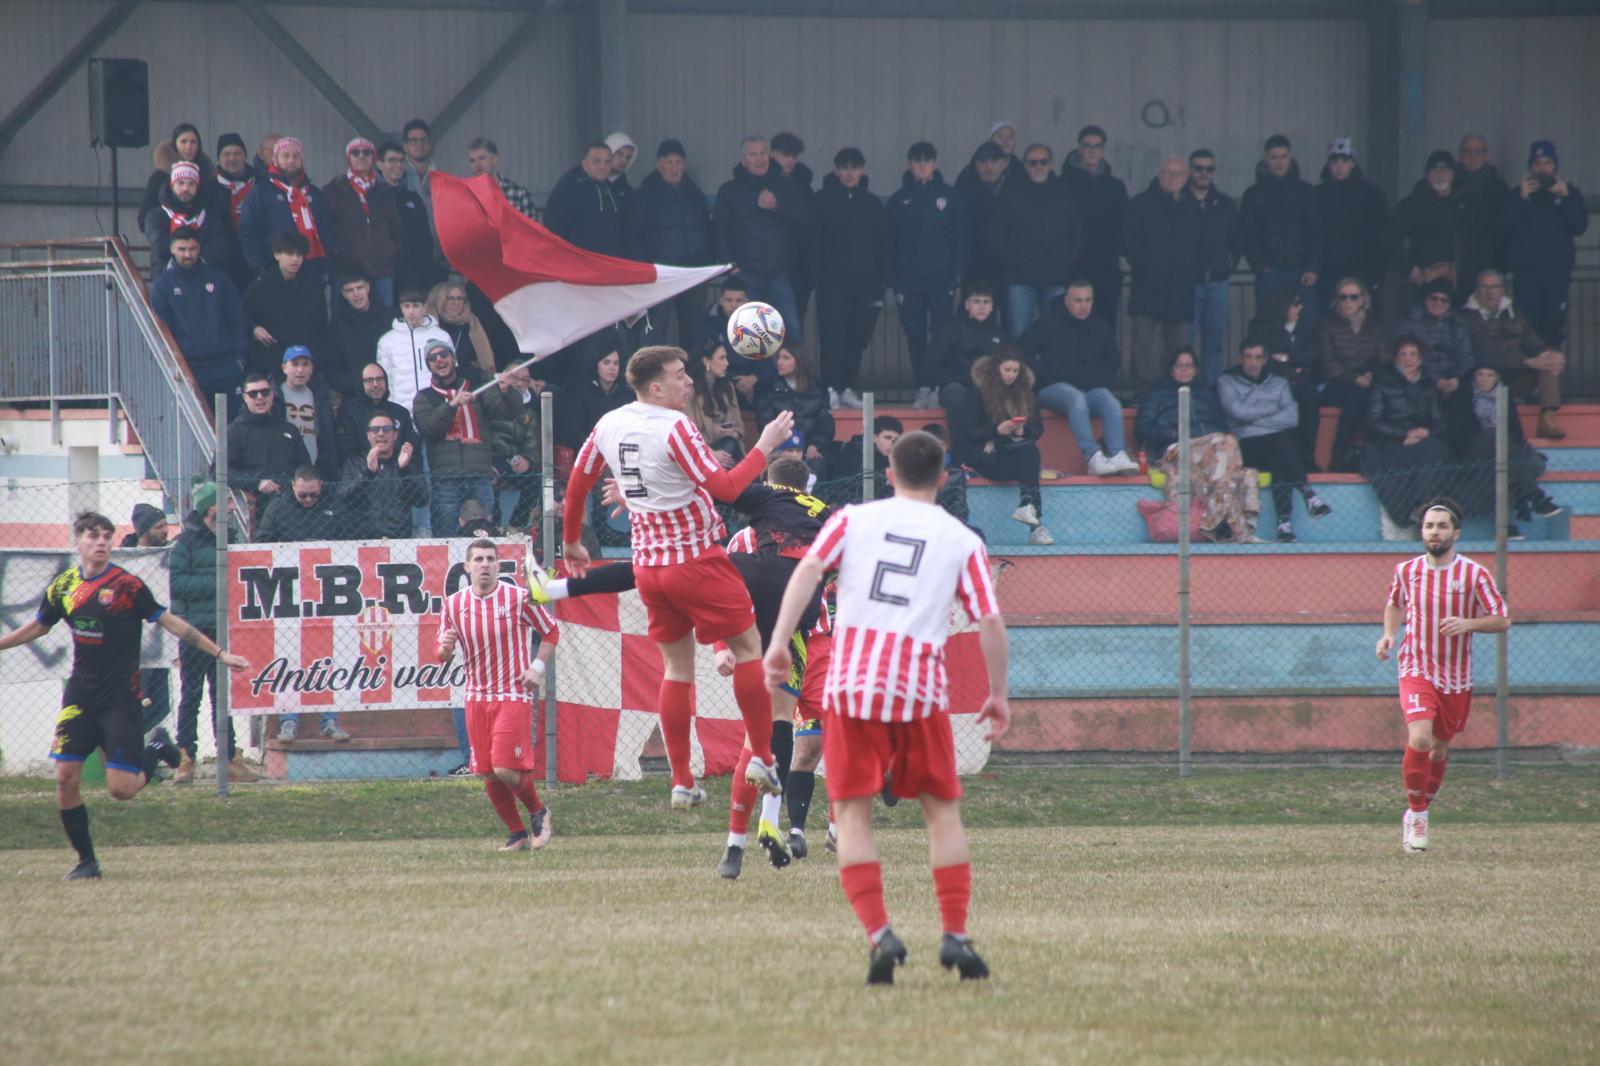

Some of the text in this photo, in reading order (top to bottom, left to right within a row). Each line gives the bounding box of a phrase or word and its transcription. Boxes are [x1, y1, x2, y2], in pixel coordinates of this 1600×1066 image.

[618, 442, 648, 498] 5
[869, 533, 926, 606] 2
[252, 656, 386, 696] Antichi
[1408, 693, 1420, 707] 4
